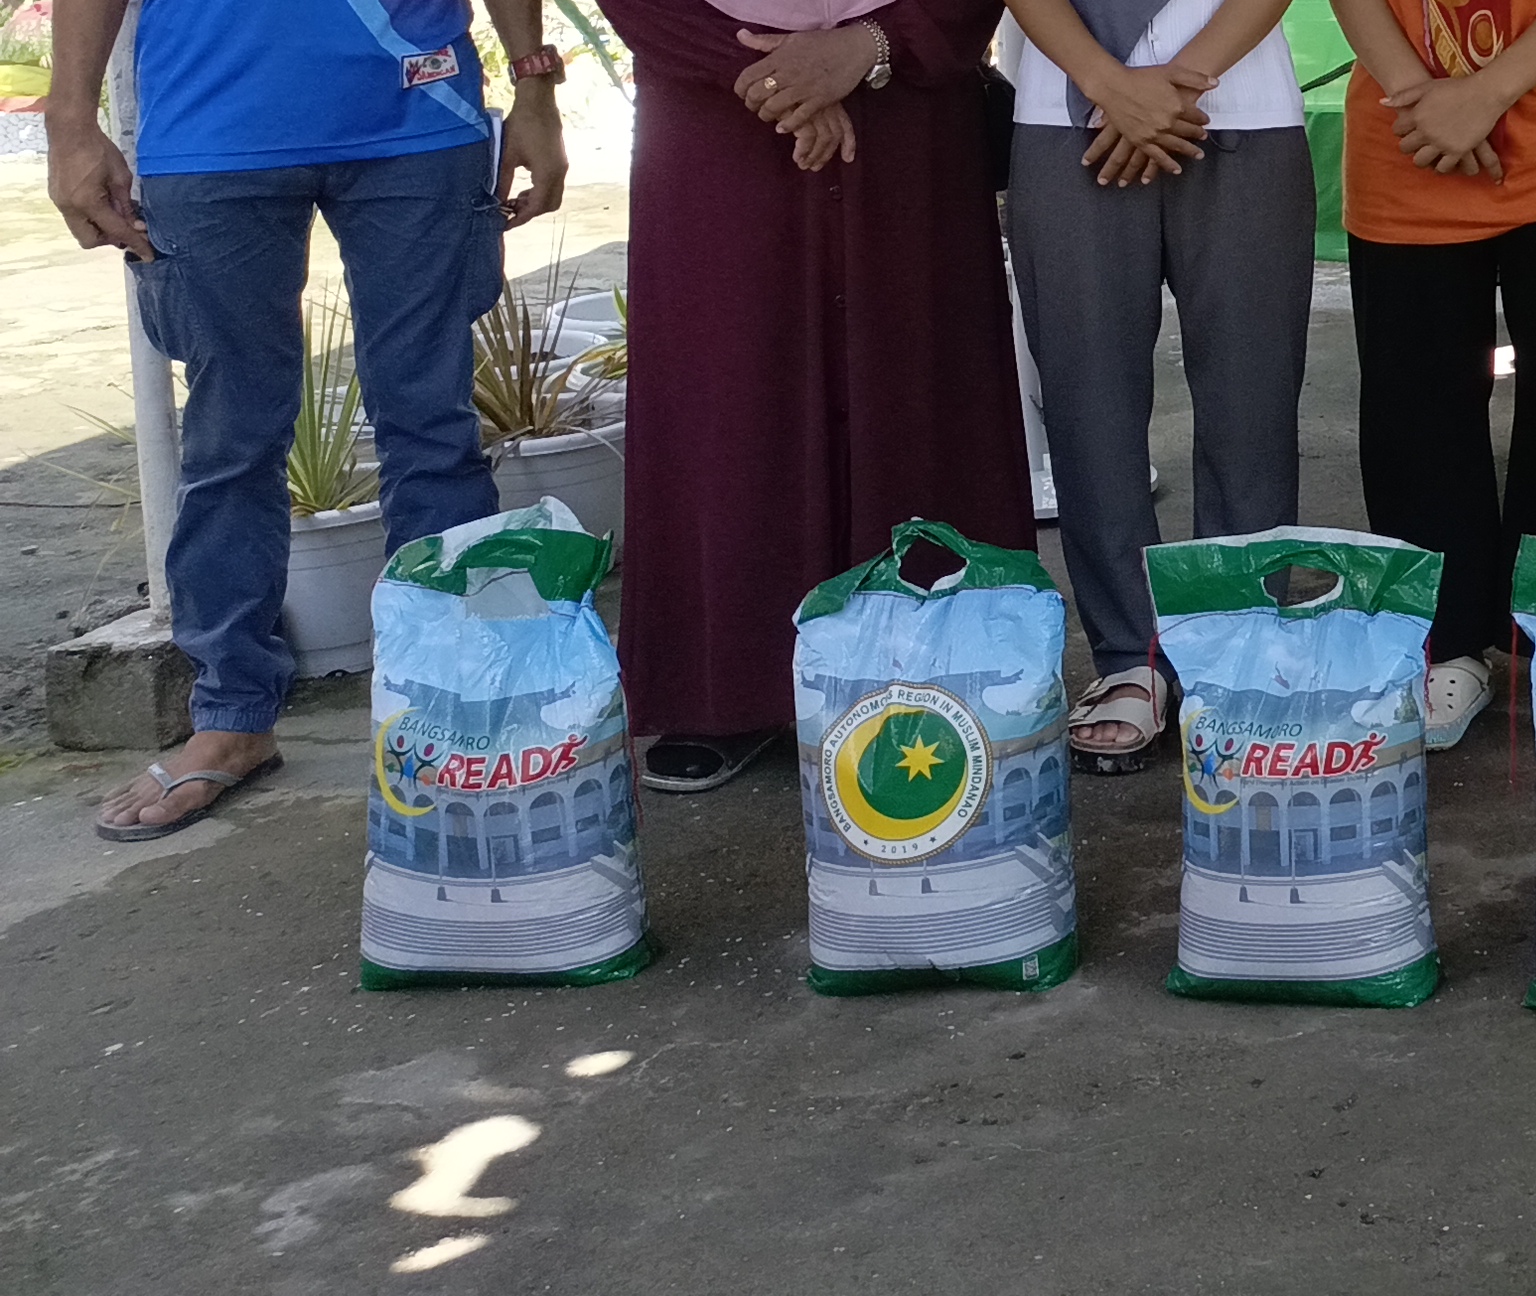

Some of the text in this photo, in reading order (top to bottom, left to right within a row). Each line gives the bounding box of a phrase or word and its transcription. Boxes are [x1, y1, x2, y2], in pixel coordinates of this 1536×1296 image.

[939, 700, 954, 714] IN
[951, 712, 981, 753] MUSLIM
[437, 746, 553, 790] READ
[1241, 741, 1354, 778] READ
[823, 748, 852, 834] BANGSAMORO
[957, 754, 984, 819] MINDANAO
[880, 842, 919, 854] 2019
